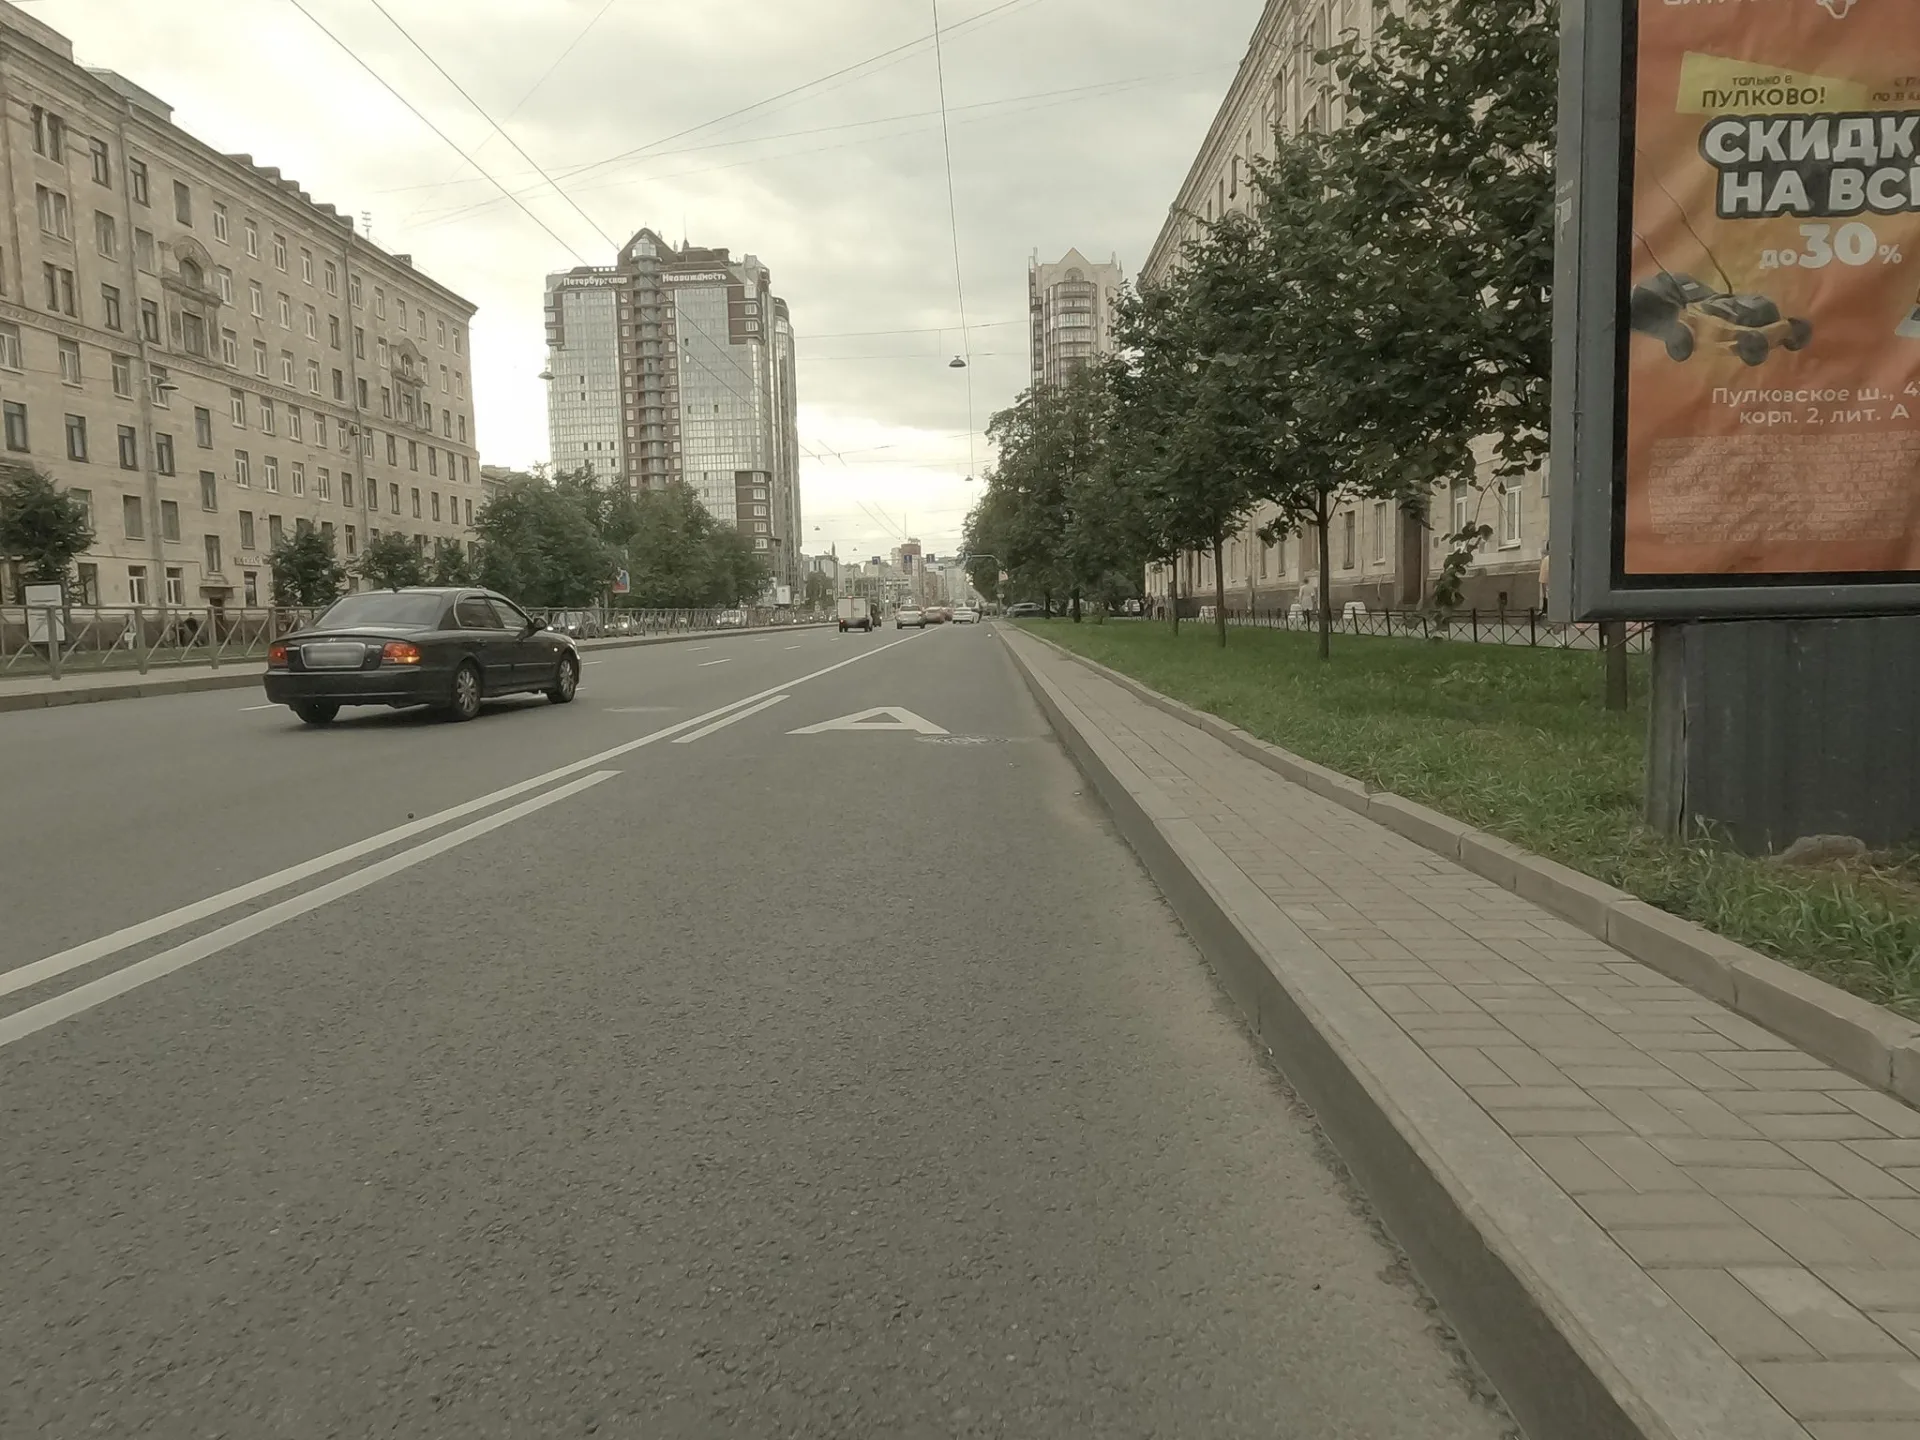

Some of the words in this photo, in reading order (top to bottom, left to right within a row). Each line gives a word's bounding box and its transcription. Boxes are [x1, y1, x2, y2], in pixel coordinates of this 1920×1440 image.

[1732, 76, 1781, 86] только
[1702, 87, 1826, 108] ПУЛКОВО!
[1723, 170, 1810, 213] НА
[1712, 388, 1850, 407] Пулковское
[1857, 387, 1894, 401] ш.,
[1739, 411, 1798, 427] корп.
[1806, 407, 1824, 425] 2,
[1830, 407, 1881, 423] лит.
[1890, 403, 1910, 420] А
